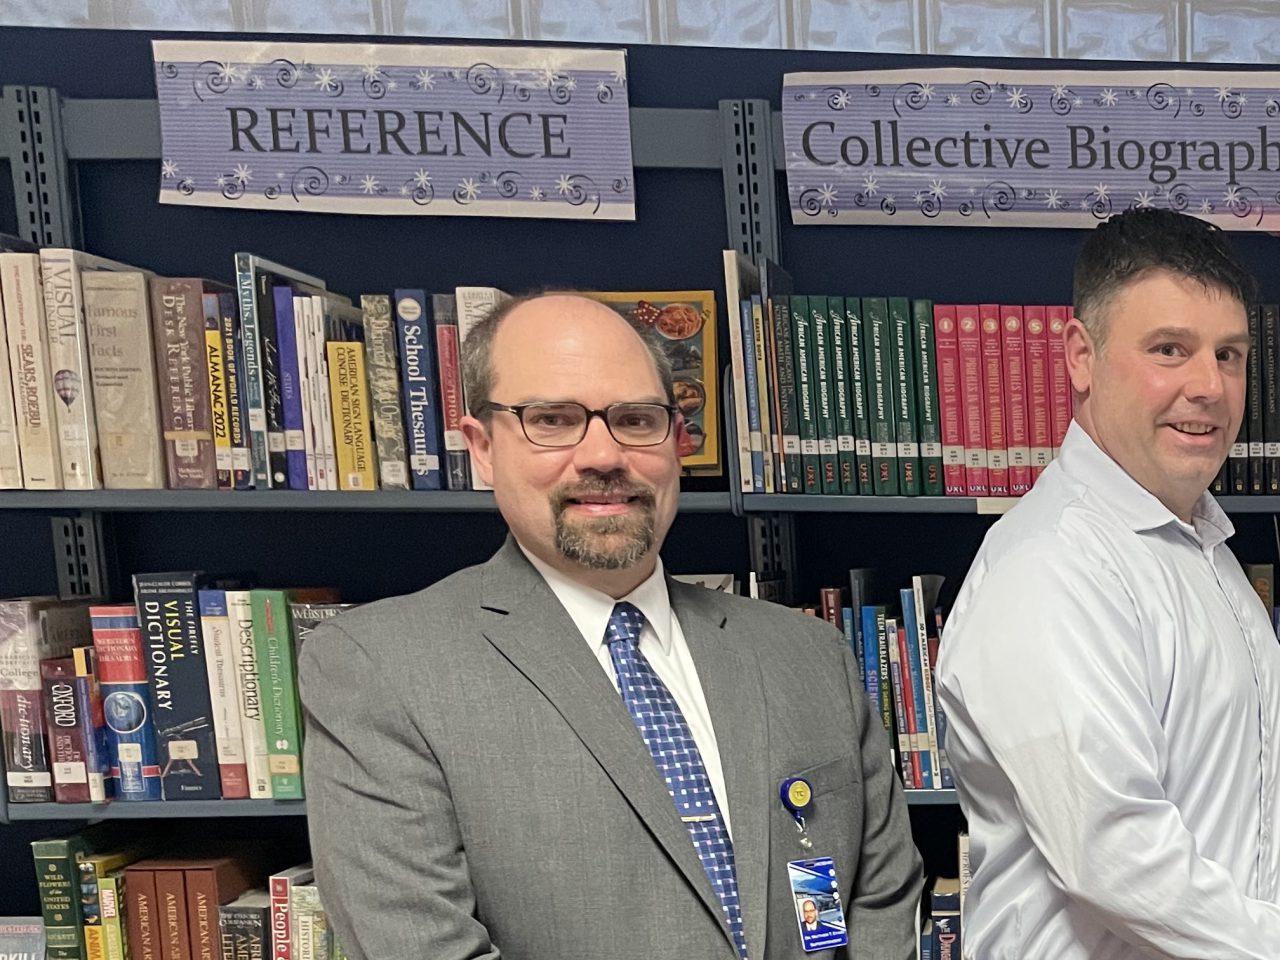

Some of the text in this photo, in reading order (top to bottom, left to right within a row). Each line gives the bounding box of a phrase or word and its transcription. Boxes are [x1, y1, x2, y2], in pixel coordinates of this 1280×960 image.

[226, 106, 572, 159] REFERENCE
[802, 119, 1051, 170] Collective
[55, 268, 76, 346] VISUAL
[175, 295, 186, 313] The
[177, 316, 188, 338] New
[226, 338, 235, 361] BOOK
[228, 363, 236, 373] OF
[242, 324, 258, 375] Legends
[794, 313, 810, 420] AFRICAN AMERICAN BIOGRAPHY
[813, 310, 829, 418] AFRICAN AMERICAN BIOGRAPHY
[167, 343, 182, 431] REFERENC
[182, 367, 194, 396] Public
[208, 345, 225, 438] ALMANAC 2022
[229, 375, 238, 404] WORLD
[337, 347, 353, 446] CONCISE DICTIONARY
[404, 325, 431, 476] School Thesaurs
[25, 387, 40, 435] ROEBU
[185, 398, 196, 431] Librar
[232, 407, 242, 444] RECORDS
[347, 347, 366, 472] AMERICAN SIGN LANGUAGE
[991, 486, 1008, 494] UXL
[164, 600, 183, 660] VISUAL
[185, 600, 198, 654] THE FIREFLY
[145, 601, 172, 710] DICTIONARY
[238, 619, 260, 721] Descriptionary
[878, 632, 888, 680] TRAILBLAZERS
[53, 685, 76, 726] OXFORD
[271, 687, 287, 736] Dictionary
[102, 889, 115, 918] MARVEL
[138, 894, 151, 944] AMERICAN
[197, 892, 211, 944] AMERICAN
[275, 903, 291, 951] People
